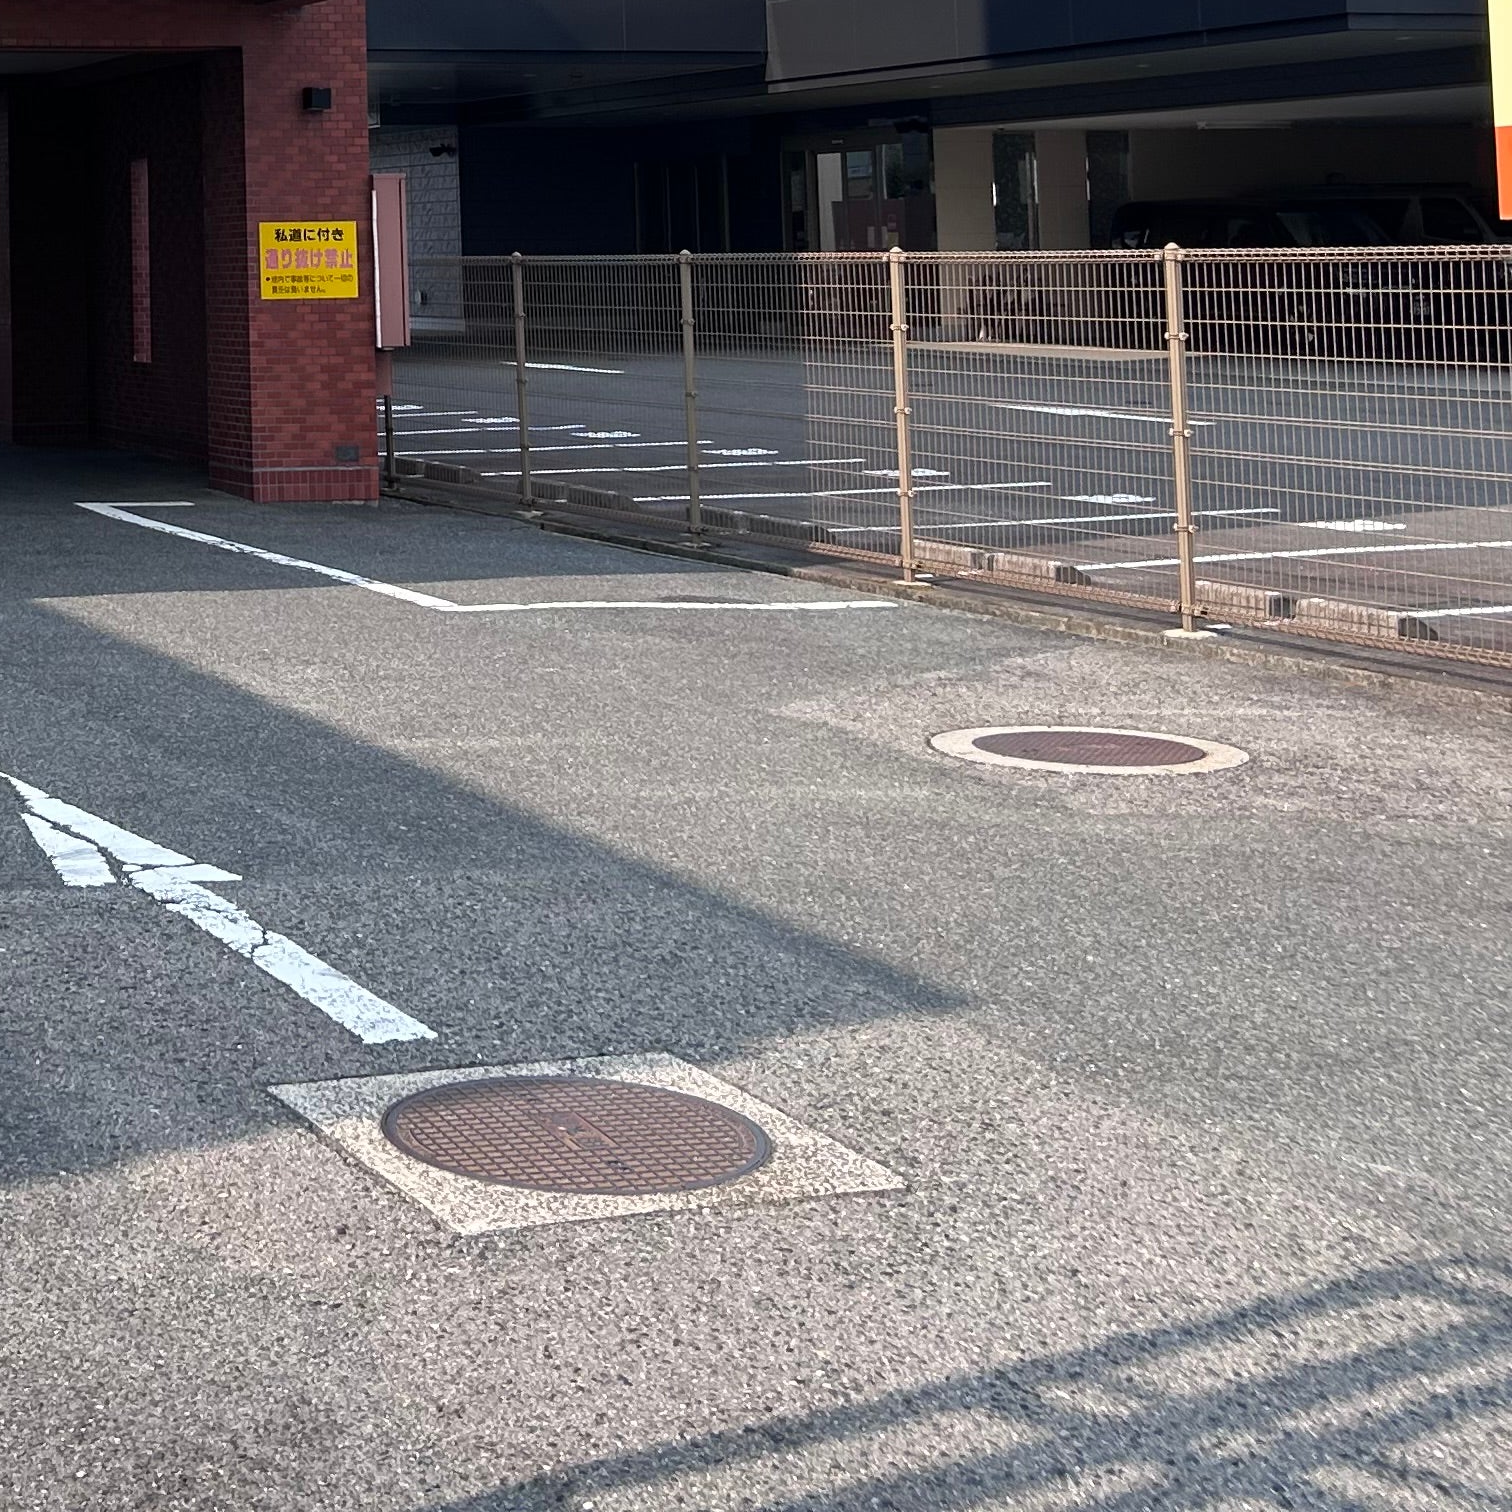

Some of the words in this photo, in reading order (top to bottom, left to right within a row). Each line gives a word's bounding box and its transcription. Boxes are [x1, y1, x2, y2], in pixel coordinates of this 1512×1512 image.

[274, 228, 344, 242] 私道に付き
[265, 247, 353, 270] 通り抜け禁止
